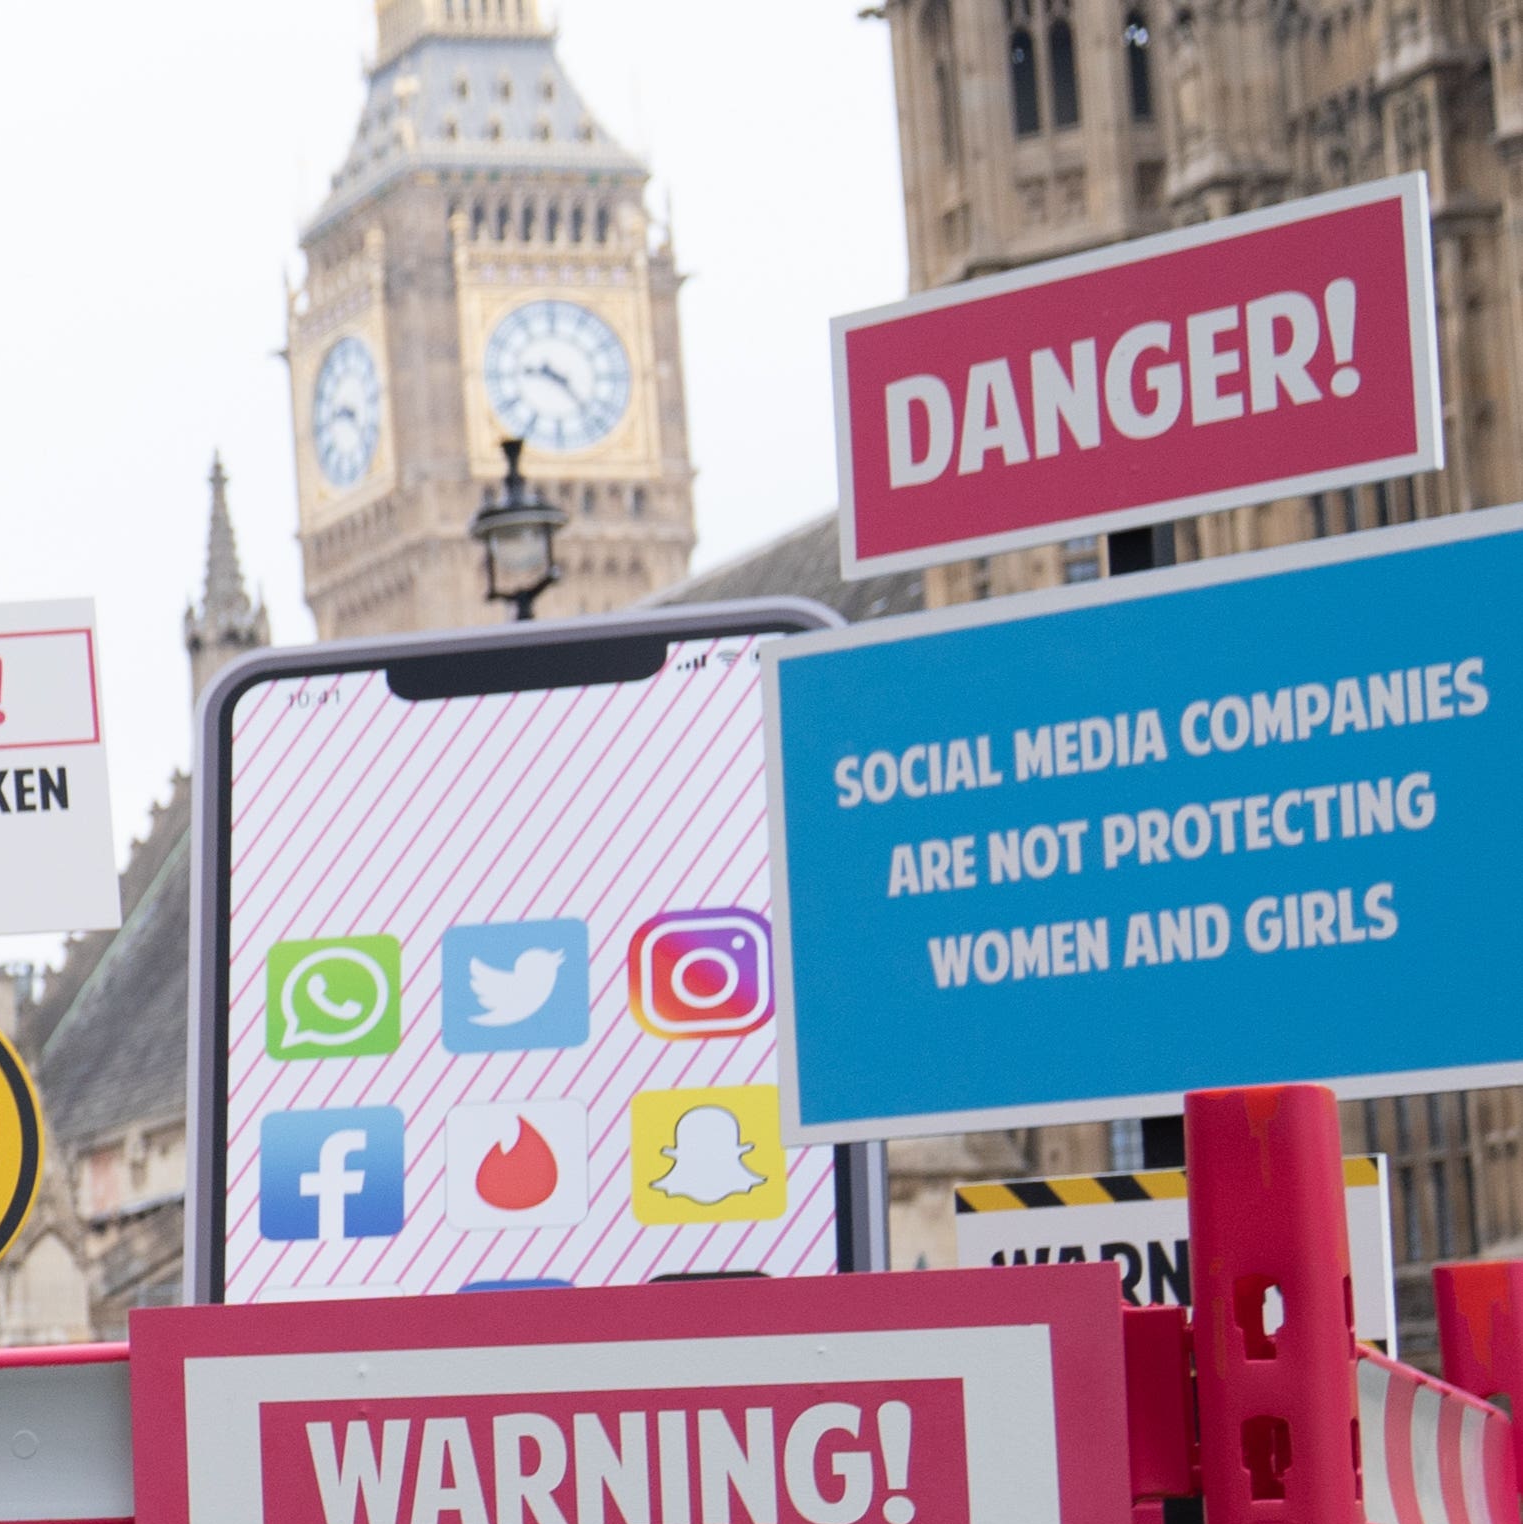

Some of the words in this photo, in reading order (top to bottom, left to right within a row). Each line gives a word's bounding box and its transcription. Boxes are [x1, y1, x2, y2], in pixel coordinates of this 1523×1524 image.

[884, 276, 1362, 491] DANGER!
[833, 734, 1003, 808] SOCIAL
[1013, 708, 1168, 783] MEDIA
[1179, 657, 1490, 757] COMPANIES
[887, 834, 978, 898] ARE
[987, 819, 1089, 885] NOT
[1101, 771, 1437, 870] PROTECTING
[927, 916, 1111, 989] WOMEN
[1123, 902, 1231, 968] AND
[1243, 881, 1399, 954] GIRLS
